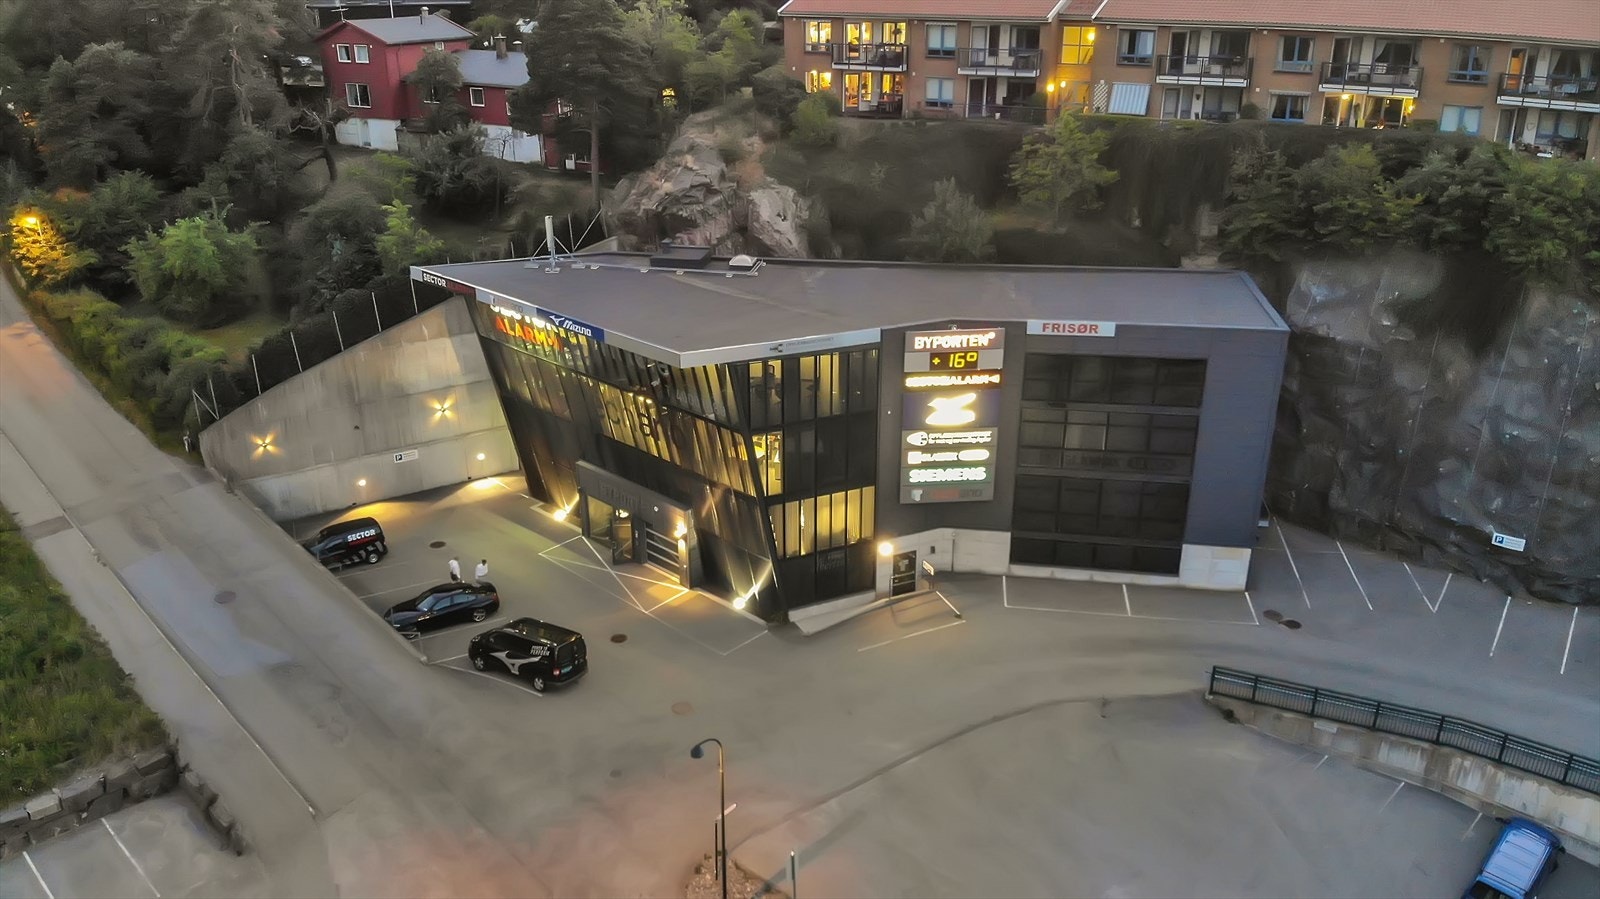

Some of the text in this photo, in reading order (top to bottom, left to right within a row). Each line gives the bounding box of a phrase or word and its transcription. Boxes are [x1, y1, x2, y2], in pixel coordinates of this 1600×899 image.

[423, 272, 447, 288] SECTOR
[1042, 322, 1099, 334] FRISØR
[347, 529, 376, 542] SECTOR
